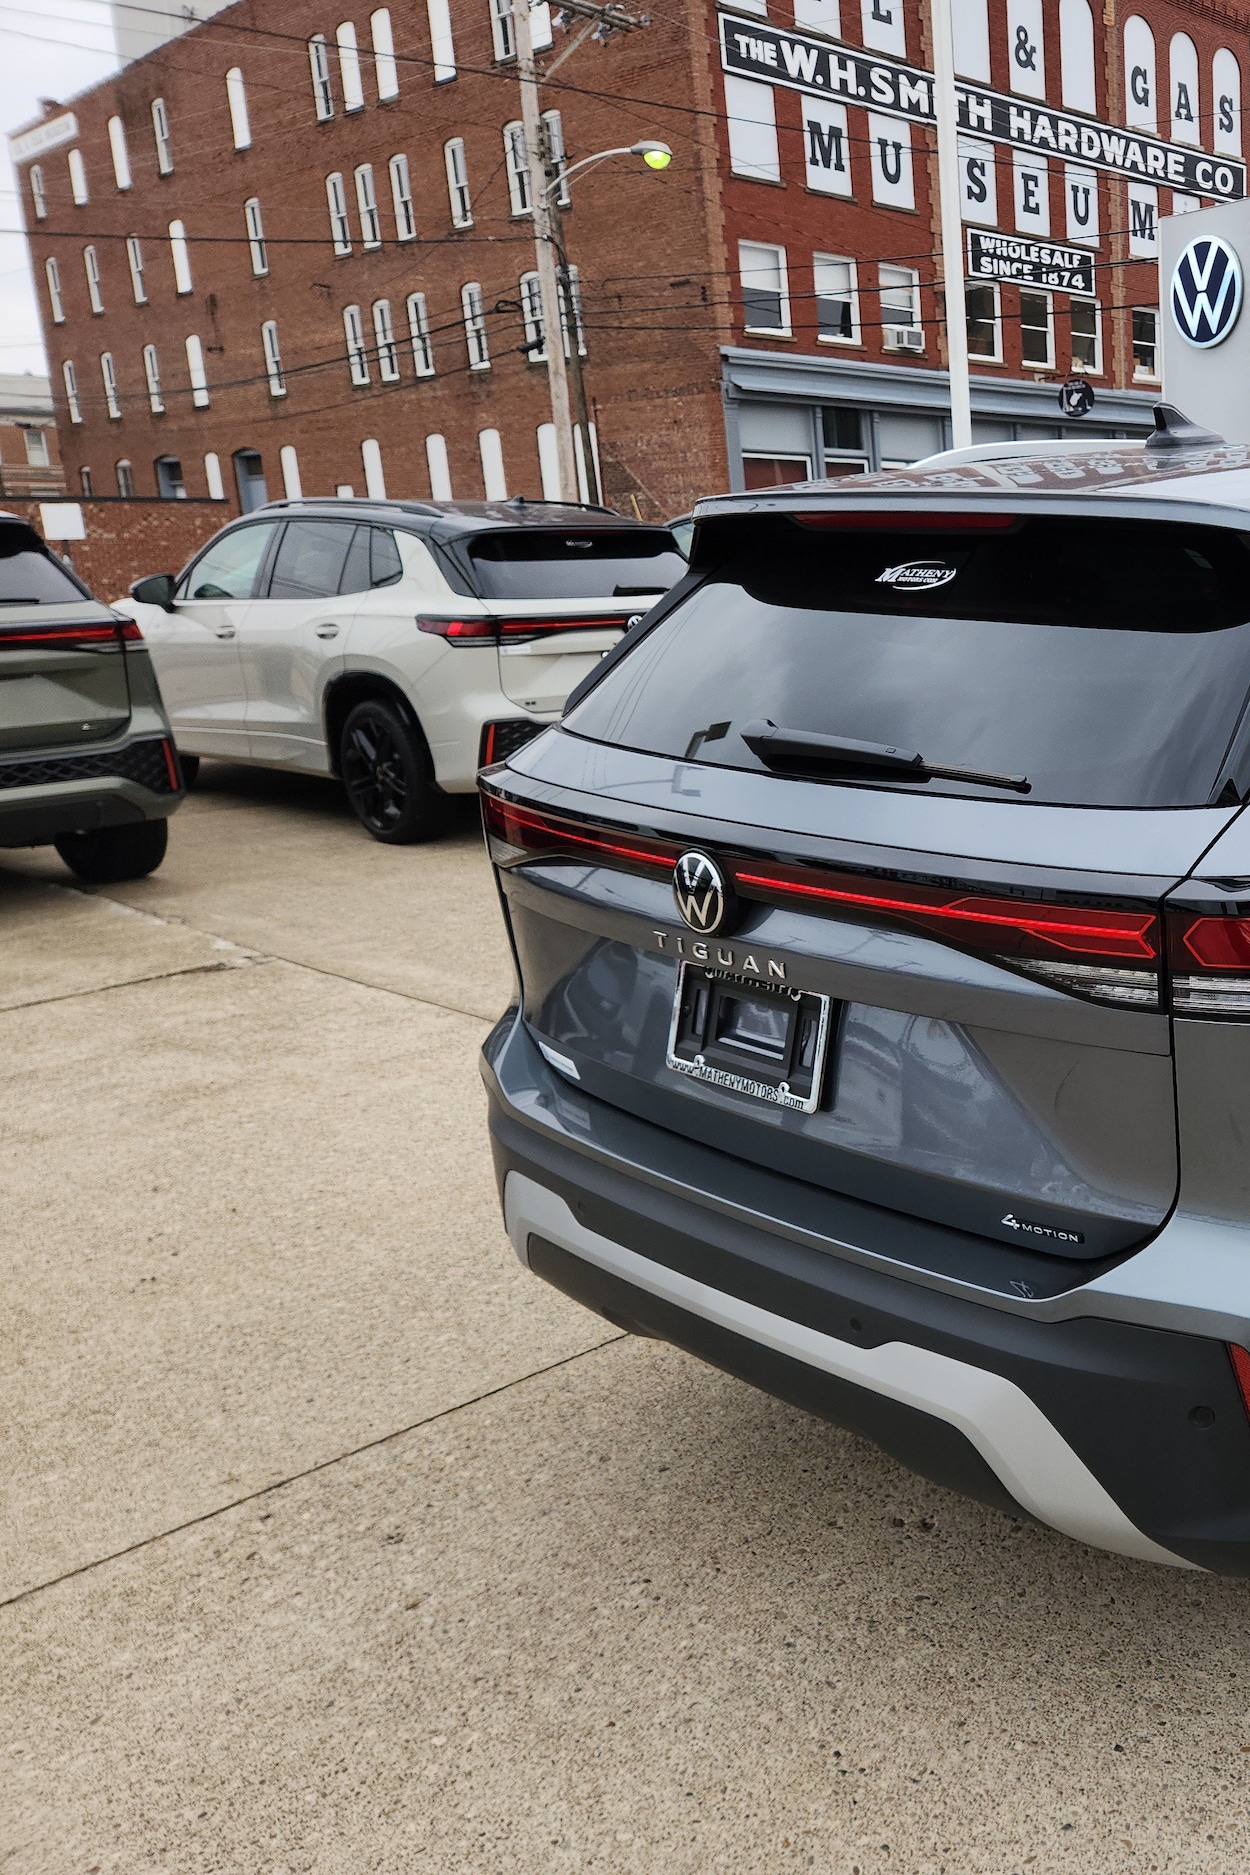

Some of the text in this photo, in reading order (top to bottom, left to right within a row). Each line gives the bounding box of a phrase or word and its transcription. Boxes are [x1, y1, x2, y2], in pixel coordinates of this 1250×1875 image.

[1015, 25, 1036, 71] &
[1131, 65, 1233, 133] GAS
[734, 33, 777, 67] THE
[1008, 106, 1185, 183] HARDWARE
[1195, 161, 1233, 194] CO
[810, 121, 1155, 241] MUSEUM
[979, 236, 1081, 269] WHOLESALE
[980, 256, 1085, 289] SINCE 1874
[875, 567, 956, 583] MATHENY
[653, 930, 786, 979] TIGUAN
